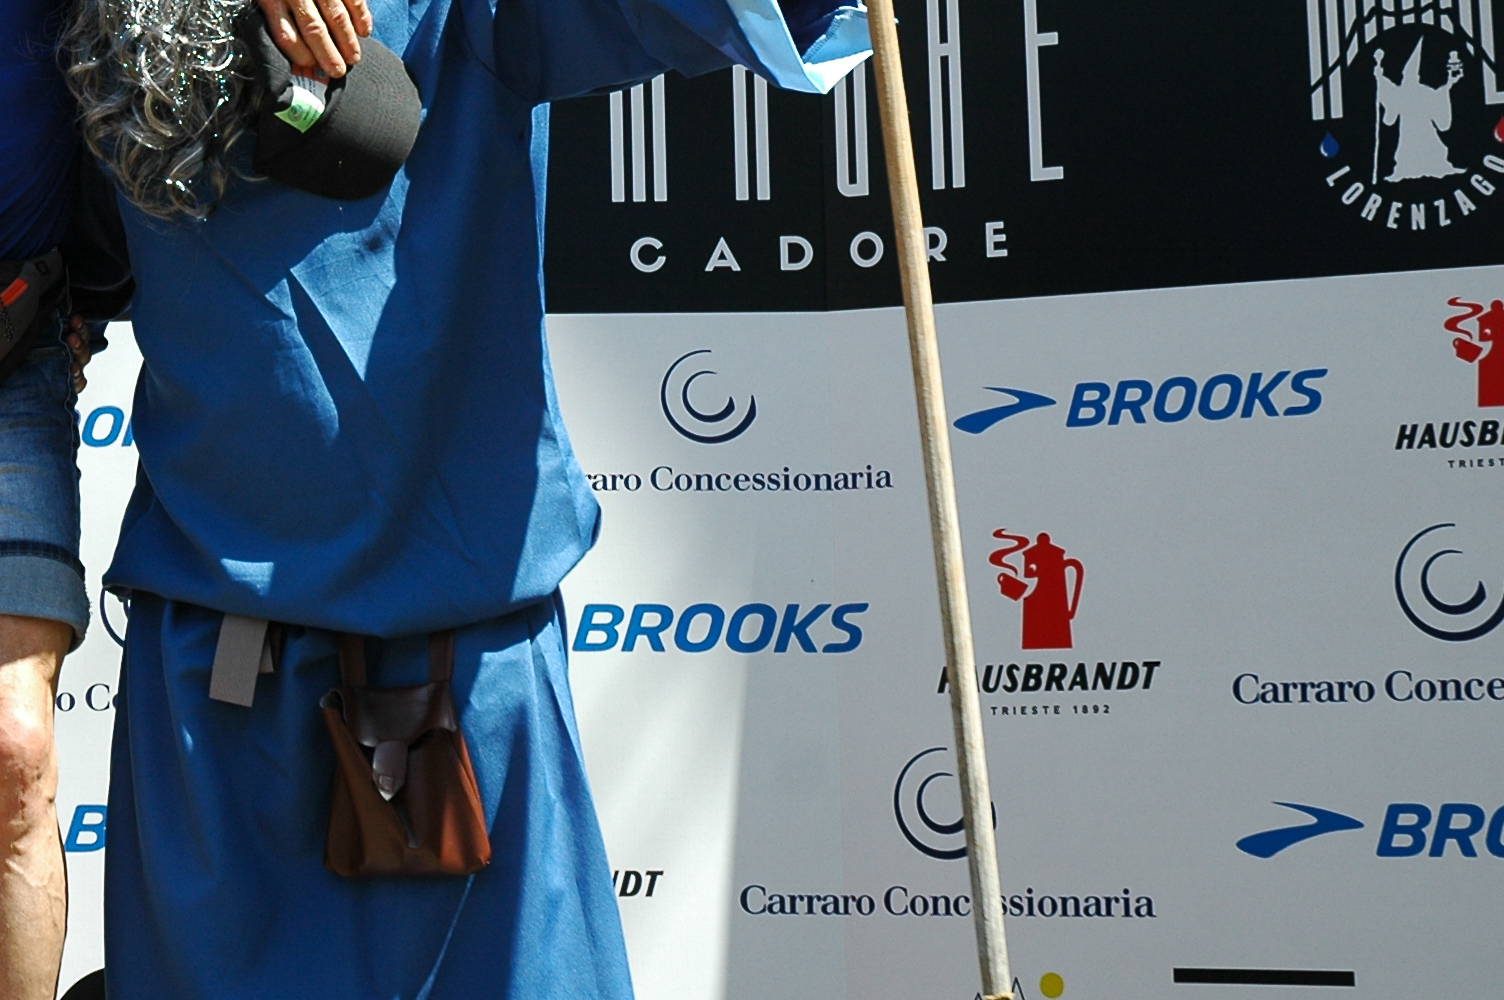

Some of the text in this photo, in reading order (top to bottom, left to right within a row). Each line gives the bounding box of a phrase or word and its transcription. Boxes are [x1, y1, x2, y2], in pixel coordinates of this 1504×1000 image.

[1326, 154, 1504, 231] LORENZAGO
[630, 221, 1008, 274] CADORE
[1066, 368, 1329, 428] BROOKS
[1395, 419, 1504, 451] HAUSB
[650, 464, 894, 492] Concessionaria
[572, 602, 870, 655] BROOKS
[1232, 673, 1376, 704] Carraro
[990, 704, 1111, 716] TRIESTE 1892
[739, 885, 876, 916] Carraro
